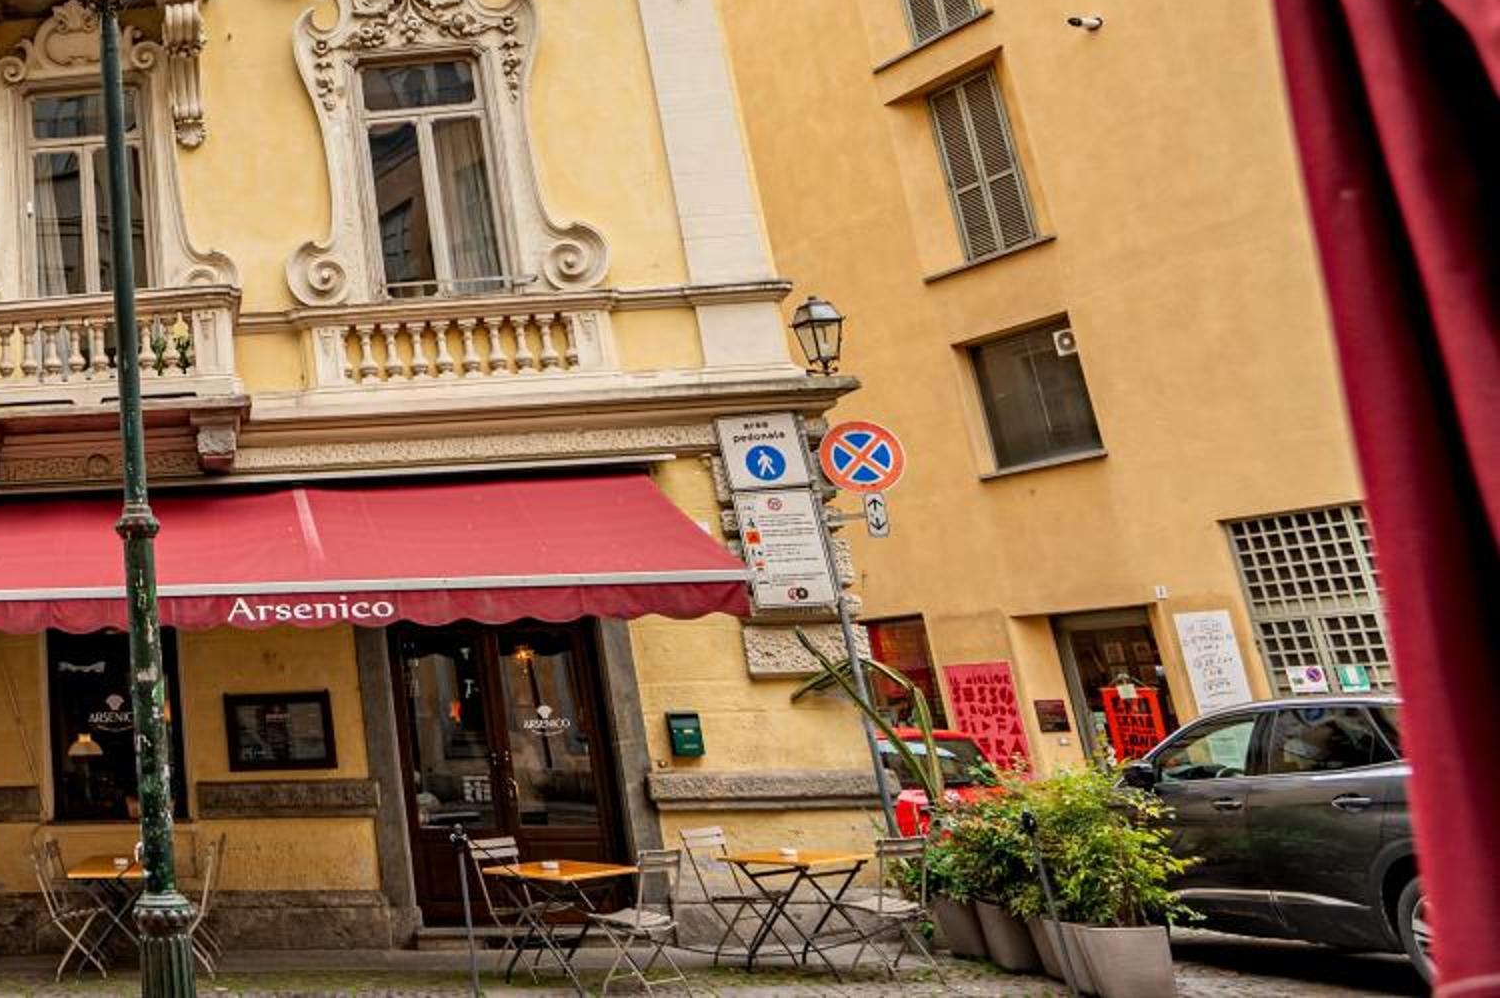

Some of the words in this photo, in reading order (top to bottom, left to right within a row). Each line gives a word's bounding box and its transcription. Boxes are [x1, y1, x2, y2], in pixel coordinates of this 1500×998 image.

[227, 596, 395, 622] Arsenico
[88, 711, 133, 723] ARSENIC
[523, 717, 571, 730] ARSENICO
